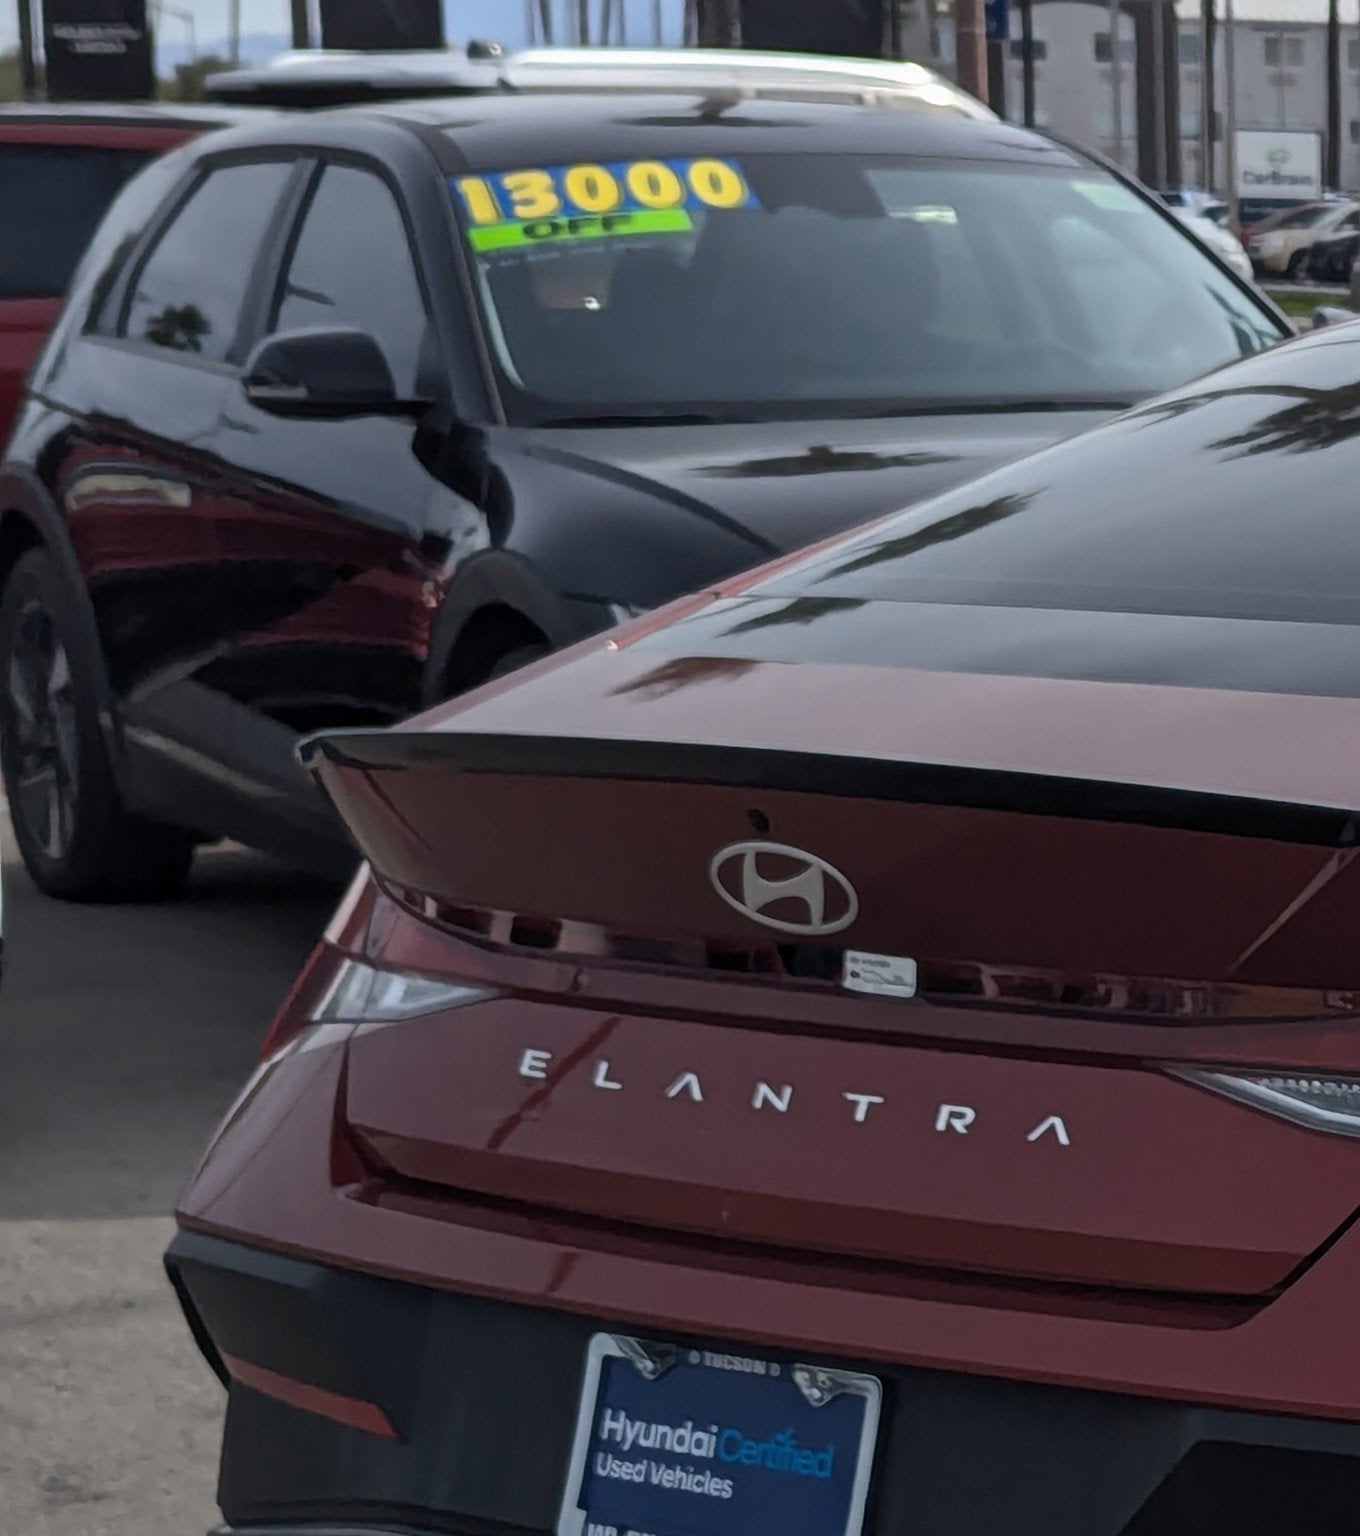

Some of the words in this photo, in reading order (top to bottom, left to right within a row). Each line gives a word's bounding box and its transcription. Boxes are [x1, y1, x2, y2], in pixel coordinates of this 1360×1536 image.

[459, 159, 747, 225] 13000
[522, 212, 632, 240] OFF
[519, 1048, 1070, 1146] ELANTRA
[596, 1451, 648, 1483] Used
[650, 1460, 734, 1499] Vehicles
[601, 1407, 719, 1459] Hyundai
[717, 1427, 835, 1478] Certified
